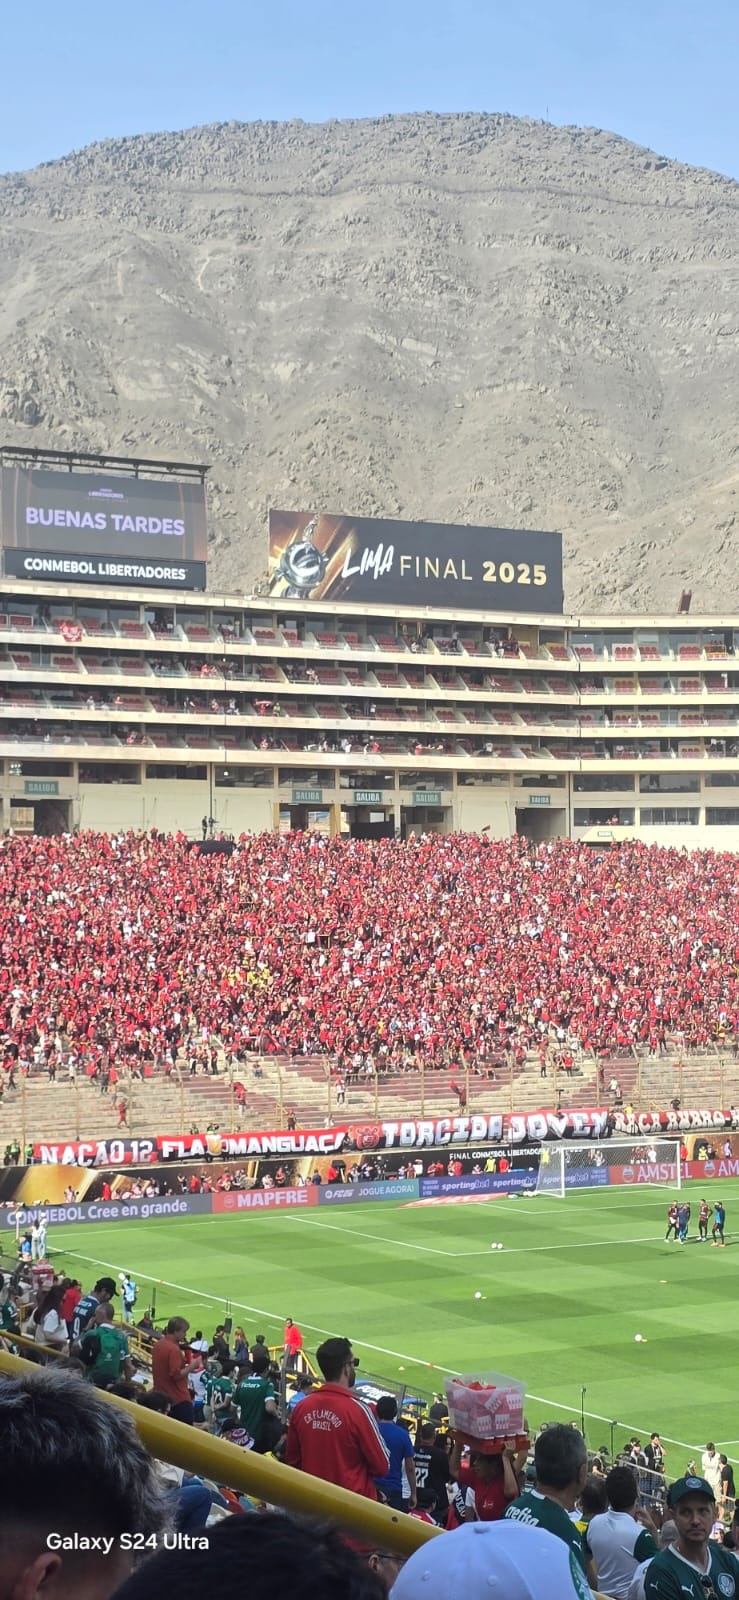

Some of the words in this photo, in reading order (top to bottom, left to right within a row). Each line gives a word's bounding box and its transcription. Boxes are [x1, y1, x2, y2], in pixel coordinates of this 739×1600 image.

[26, 507, 106, 530] BUENAS
[111, 514, 185, 536] TARDES
[24, 558, 96, 575] CONMEBOL
[98, 563, 186, 580] LIBERTADORES
[341, 543, 395, 580] LIMA
[400, 555, 473, 581] FINAL
[482, 560, 547, 586] 2025
[28, 783, 56, 793] SALIDA
[295, 791, 320, 801] SALIDA
[356, 792, 380, 802] SALIDA
[415, 793, 439, 803] SALIDA
[382, 1115, 503, 1147] TORCIDA
[130, 1140, 153, 1163] 12
[449, 1152, 471, 1161] FINAL
[472, 1149, 507, 1159] CONMEBOL
[358, 1186, 384, 1197] JOGUE
[384, 1184, 414, 1195] AGORA!
[493, 1176, 538, 1189] sportingbe
[237, 1189, 308, 1208] MAPFRE
[88, 1204, 120, 1219] Cree
[121, 1206, 138, 1216] en
[141, 1199, 188, 1219] grande
[312, 1409, 342, 1428] FLAMENGO
[312, 1420, 331, 1432] BRASIL
[504, 1505, 540, 1527] crefisa
